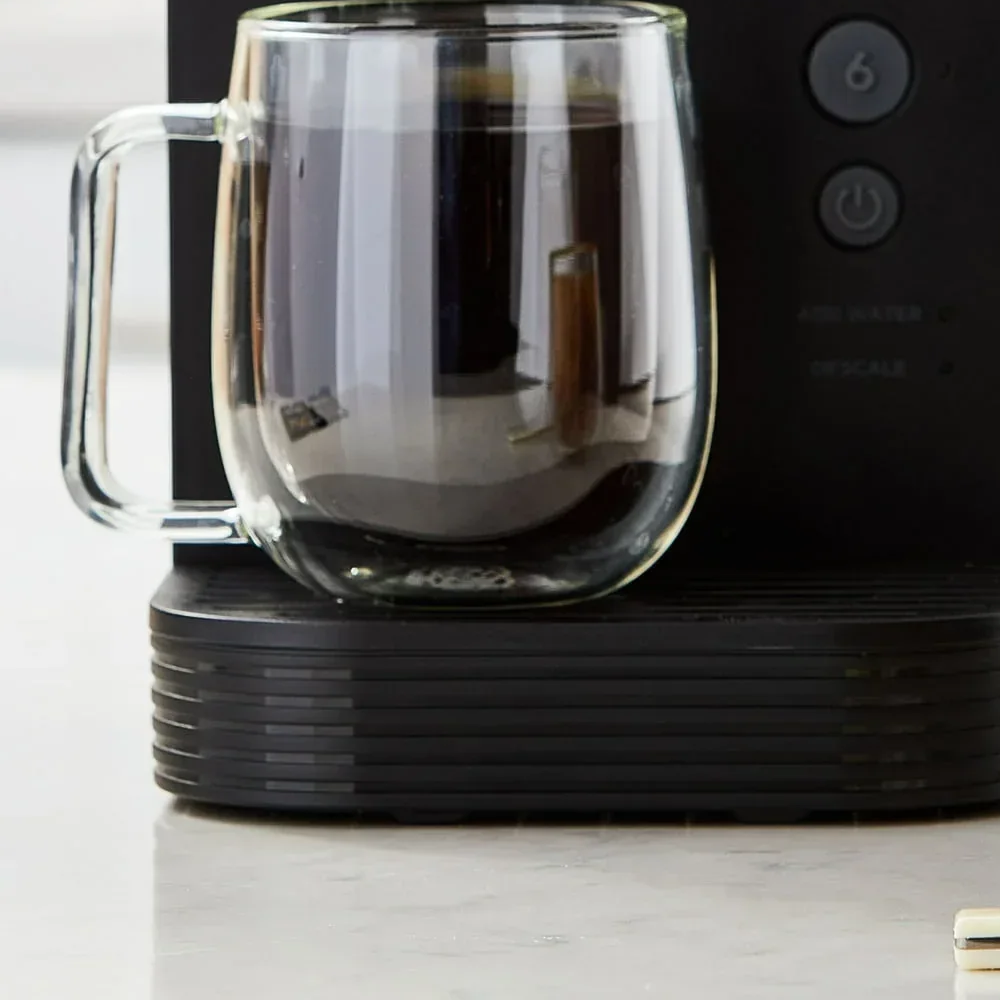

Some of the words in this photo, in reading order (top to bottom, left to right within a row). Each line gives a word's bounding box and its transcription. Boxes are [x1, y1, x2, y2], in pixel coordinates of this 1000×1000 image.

[845, 51, 875, 92] 6
[847, 304, 923, 322] WATER
[809, 359, 908, 378] DESCALE
